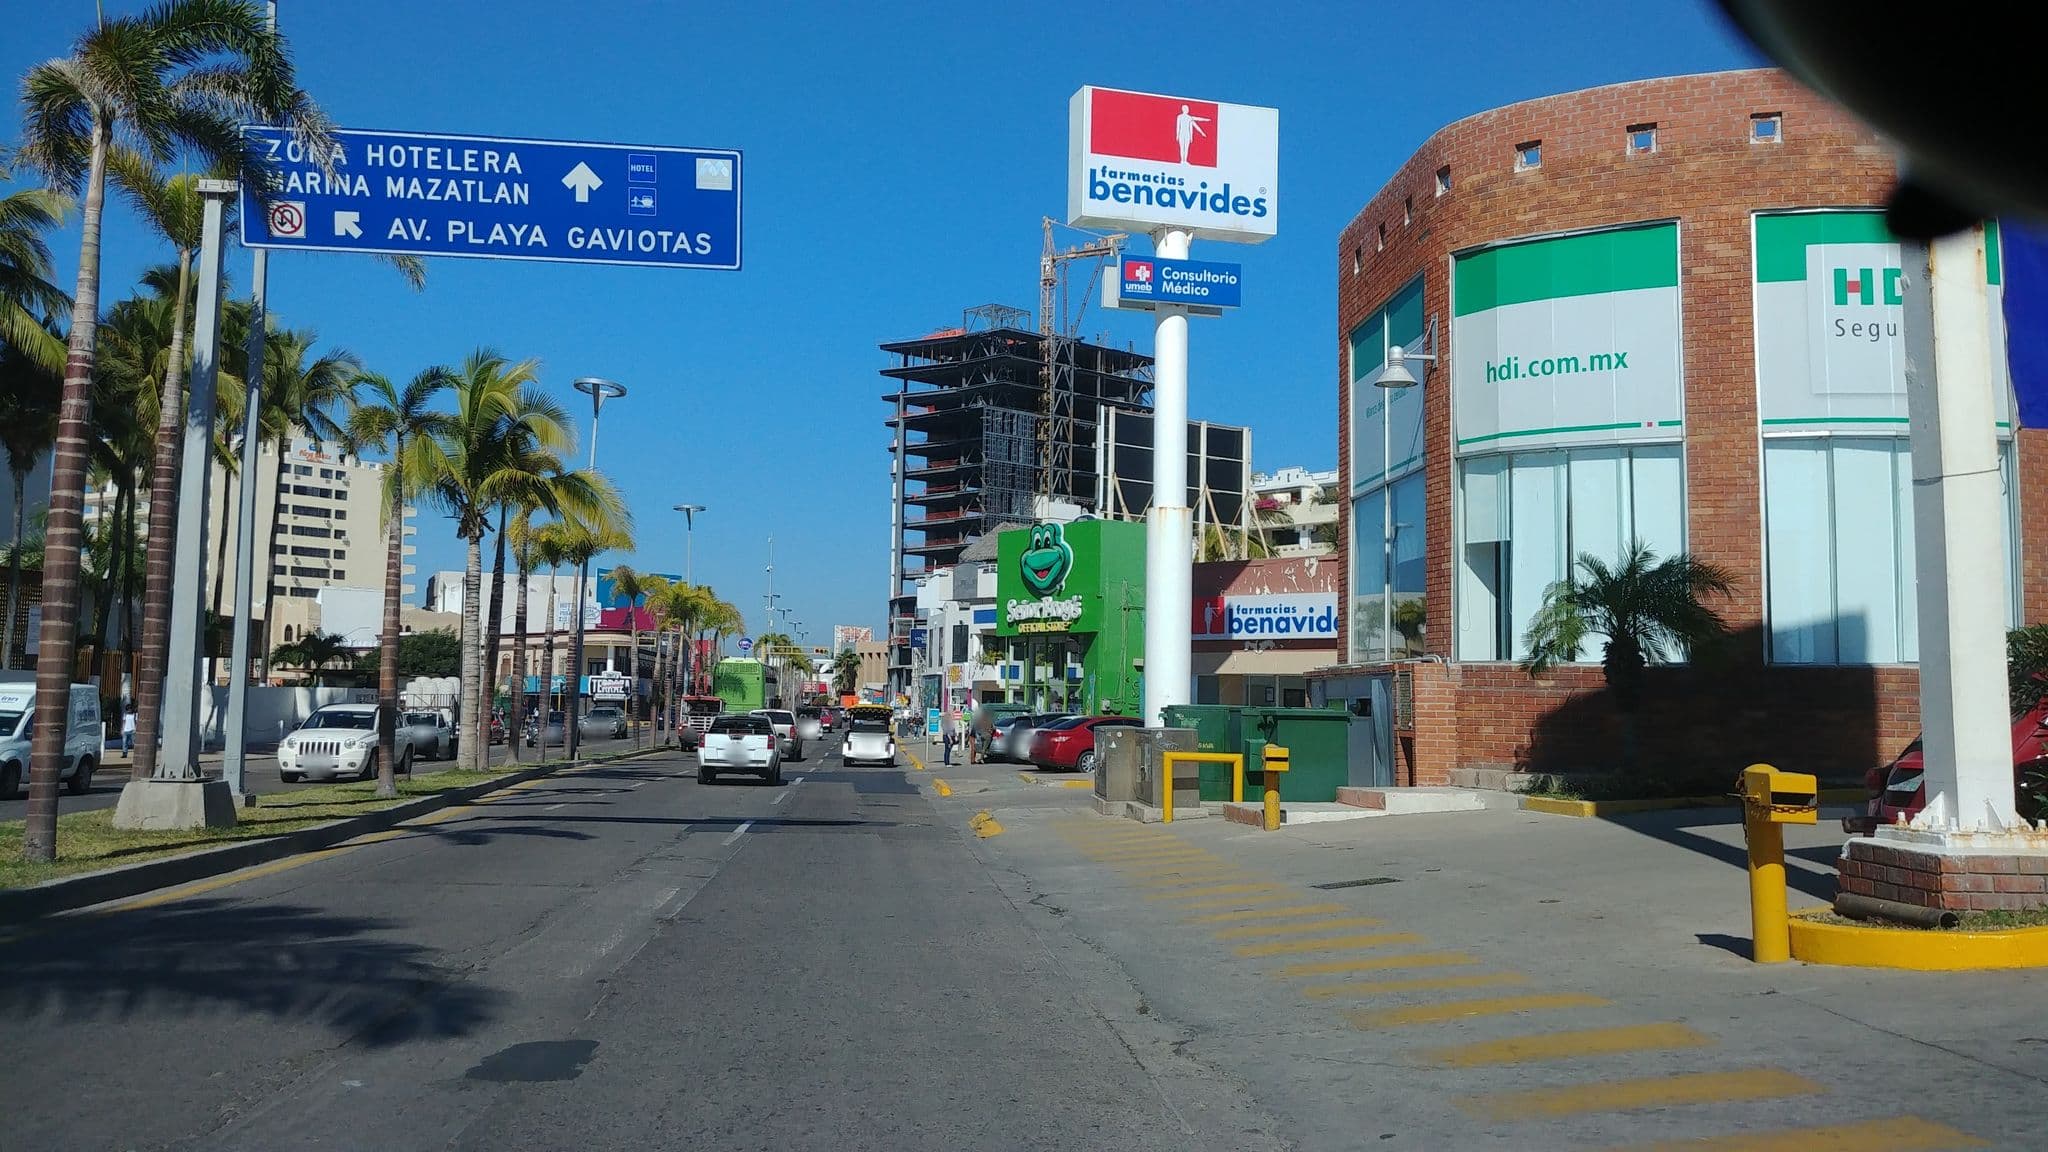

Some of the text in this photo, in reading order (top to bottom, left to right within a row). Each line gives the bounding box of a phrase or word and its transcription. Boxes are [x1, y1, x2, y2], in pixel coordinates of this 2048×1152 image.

[366, 143, 523, 174] HOTELERA
[630, 164, 655, 173] HOTEL
[1101, 165, 1185, 186] farmacias
[386, 175, 529, 205] MAZATLAN
[1089, 168, 1267, 217] benavides
[387, 217, 712, 255] AV. PLAYA GAVIOTAS
[1161, 266, 1238, 284] Consultorio
[1125, 281, 1153, 291] umeb
[1161, 281, 1210, 297] Médico
[1486, 351, 1629, 384] hdi.com.mx
[1236, 603, 1297, 615] farmacias
